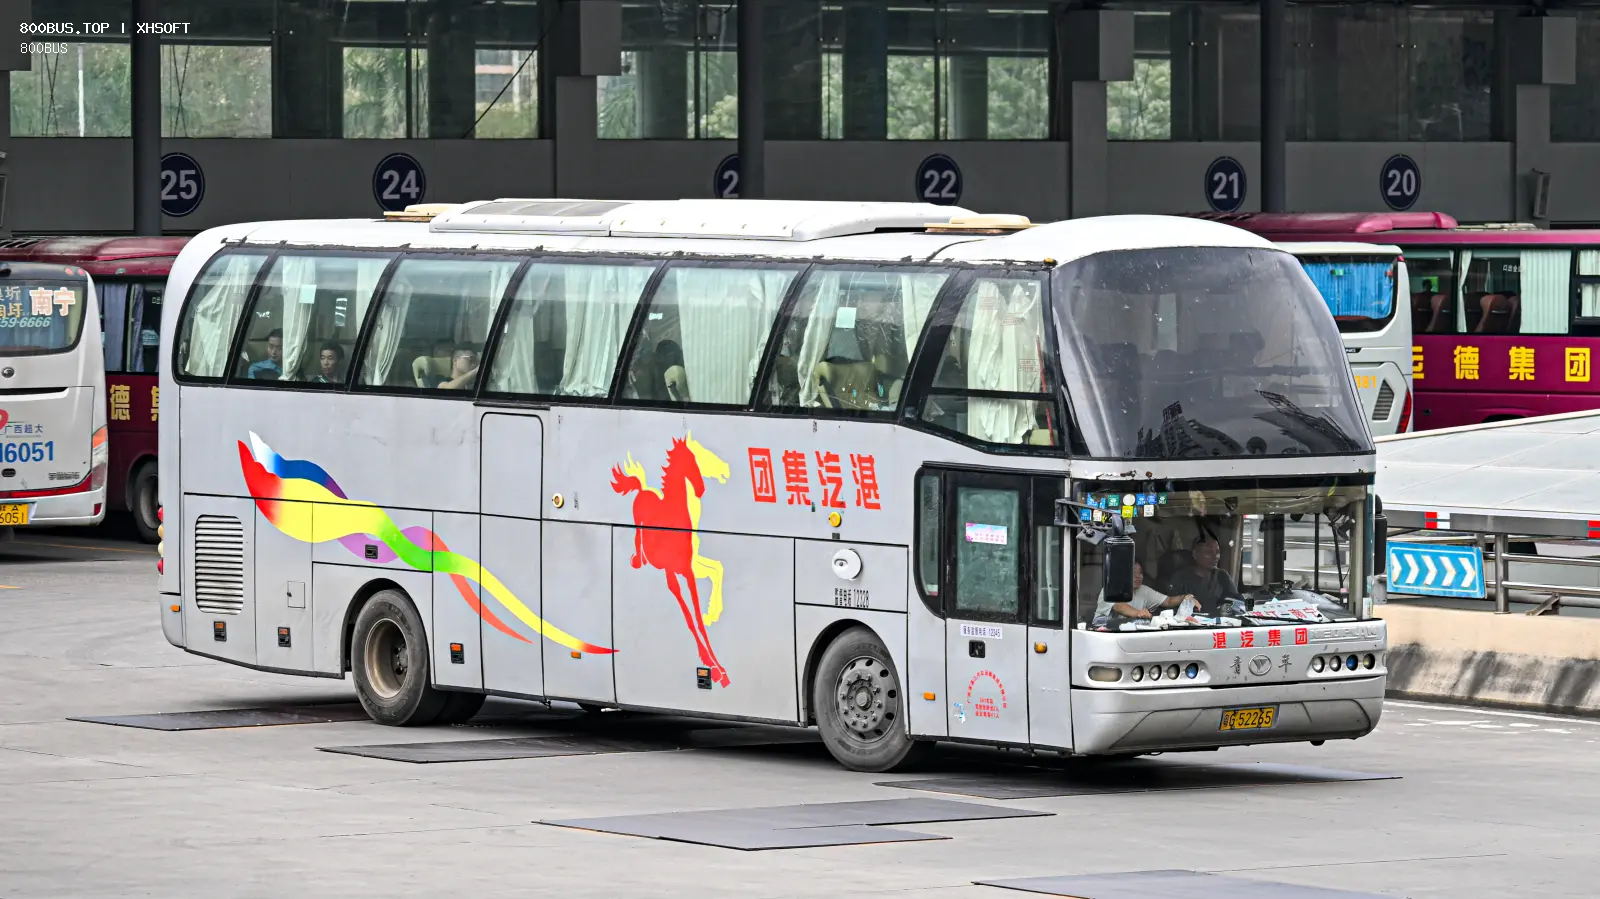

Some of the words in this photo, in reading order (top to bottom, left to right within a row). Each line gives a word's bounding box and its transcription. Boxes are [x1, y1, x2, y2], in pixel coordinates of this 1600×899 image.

[160, 170, 198, 200] 25
[382, 170, 420, 199] 24
[722, 169, 739, 198] 2
[924, 170, 957, 198] 22
[1213, 172, 1240, 199] 21
[1387, 169, 1416, 196] 20
[29, 287, 76, 316] 南宁
[4, 424, 43, 434] 广西超大
[0, 440, 54, 463] 6051
[1212, 627, 1309, 649] 湛汽集团
